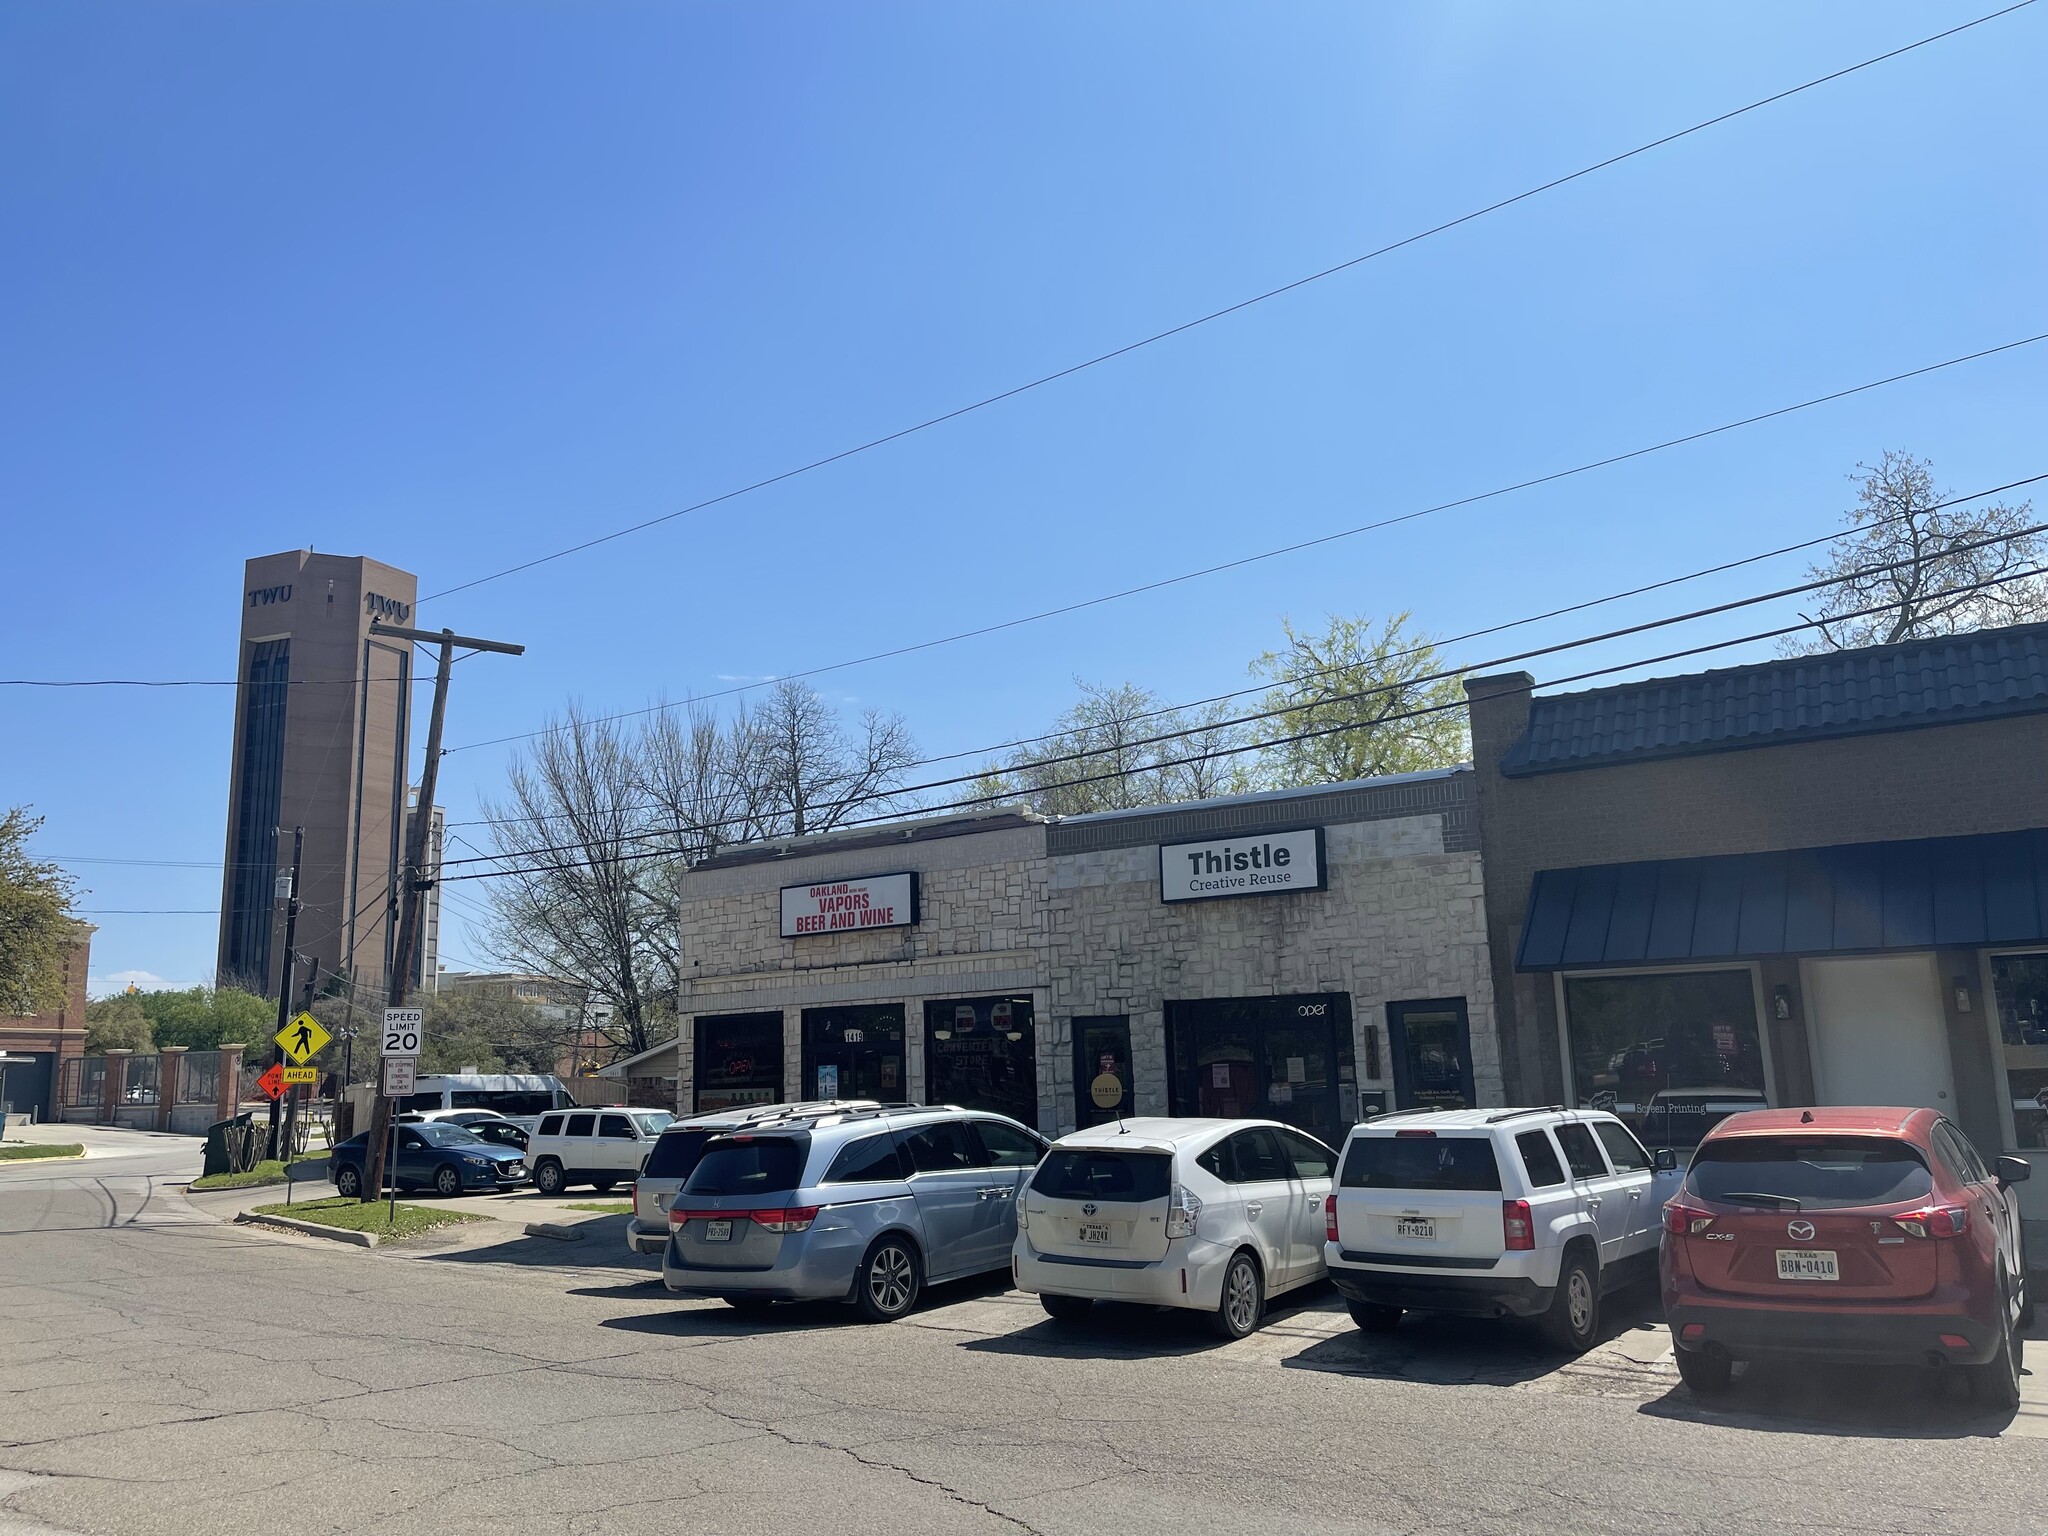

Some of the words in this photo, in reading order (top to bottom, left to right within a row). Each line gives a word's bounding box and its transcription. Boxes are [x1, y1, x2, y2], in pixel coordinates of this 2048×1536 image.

[248, 585, 292, 608] TWU
[367, 591, 411, 619] TWU
[1188, 843, 1291, 875] Thistle
[1190, 876, 1245, 892] Creative
[1249, 872, 1291, 886] Reuse
[810, 884, 848, 898] OAKLAND
[819, 893, 870, 914] VAPORS
[797, 915, 826, 933] BEER
[830, 911, 856, 929] AND
[860, 907, 894, 926] WINE
[386, 1013, 420, 1021] SPEED
[389, 1023, 416, 1031] LIMIT
[385, 1033, 418, 1050] 20
[846, 1033, 862, 1041] 1419
[287, 1071, 314, 1079] AHEAD
[729, 1059, 752, 1075] OPEN
[1636, 1103, 1666, 1113] Screen
[1668, 1103, 1706, 1115] Printing
[1706, 1233, 1735, 1241] CX-5
